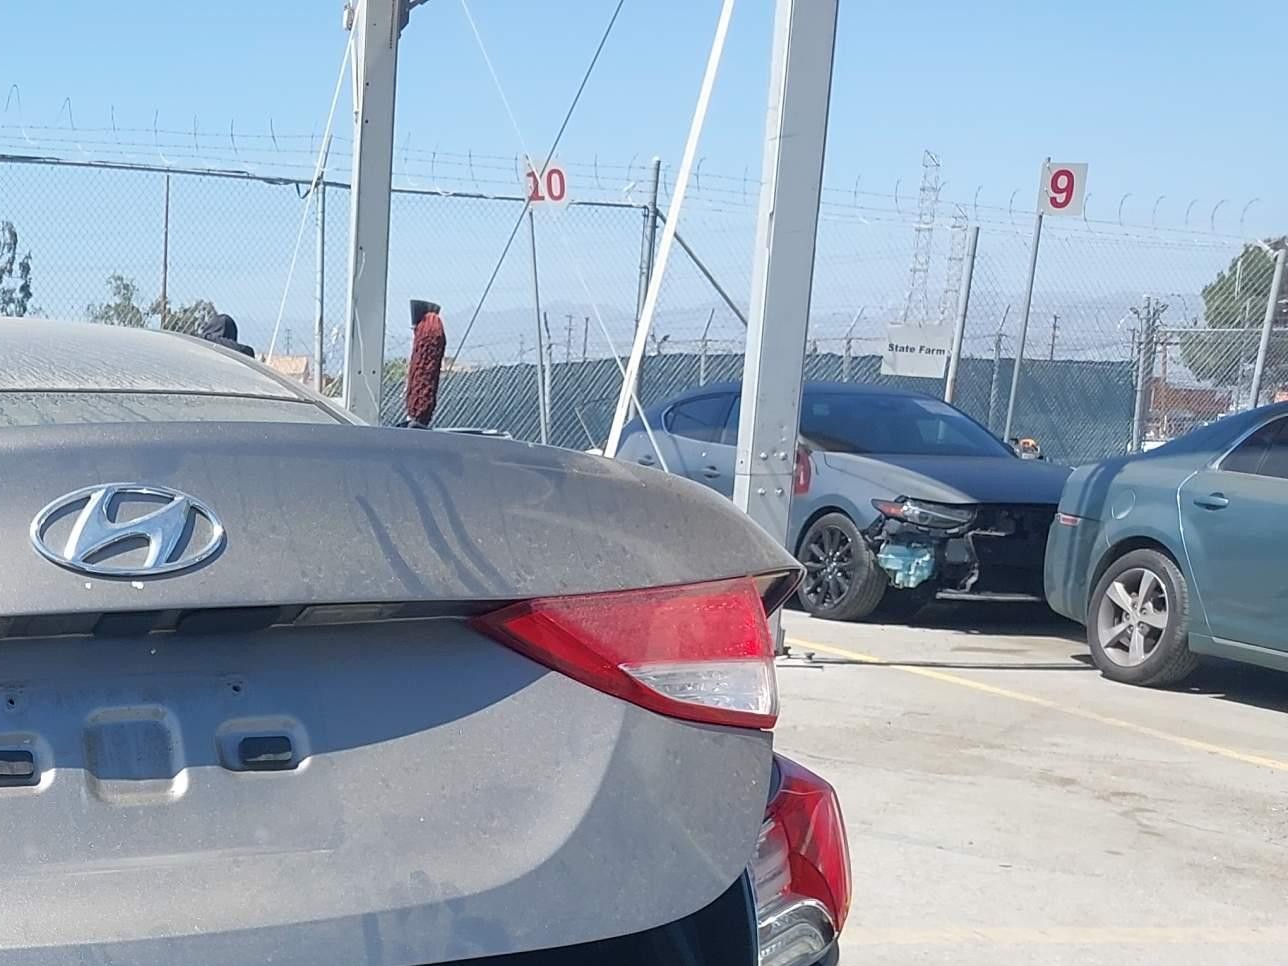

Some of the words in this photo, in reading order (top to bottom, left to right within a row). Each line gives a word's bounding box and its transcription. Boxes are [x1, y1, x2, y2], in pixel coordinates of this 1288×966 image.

[526, 168, 566, 201] 10
[1049, 169, 1075, 209] 9
[888, 343, 916, 353] State
[918, 345, 946, 356] Farm
